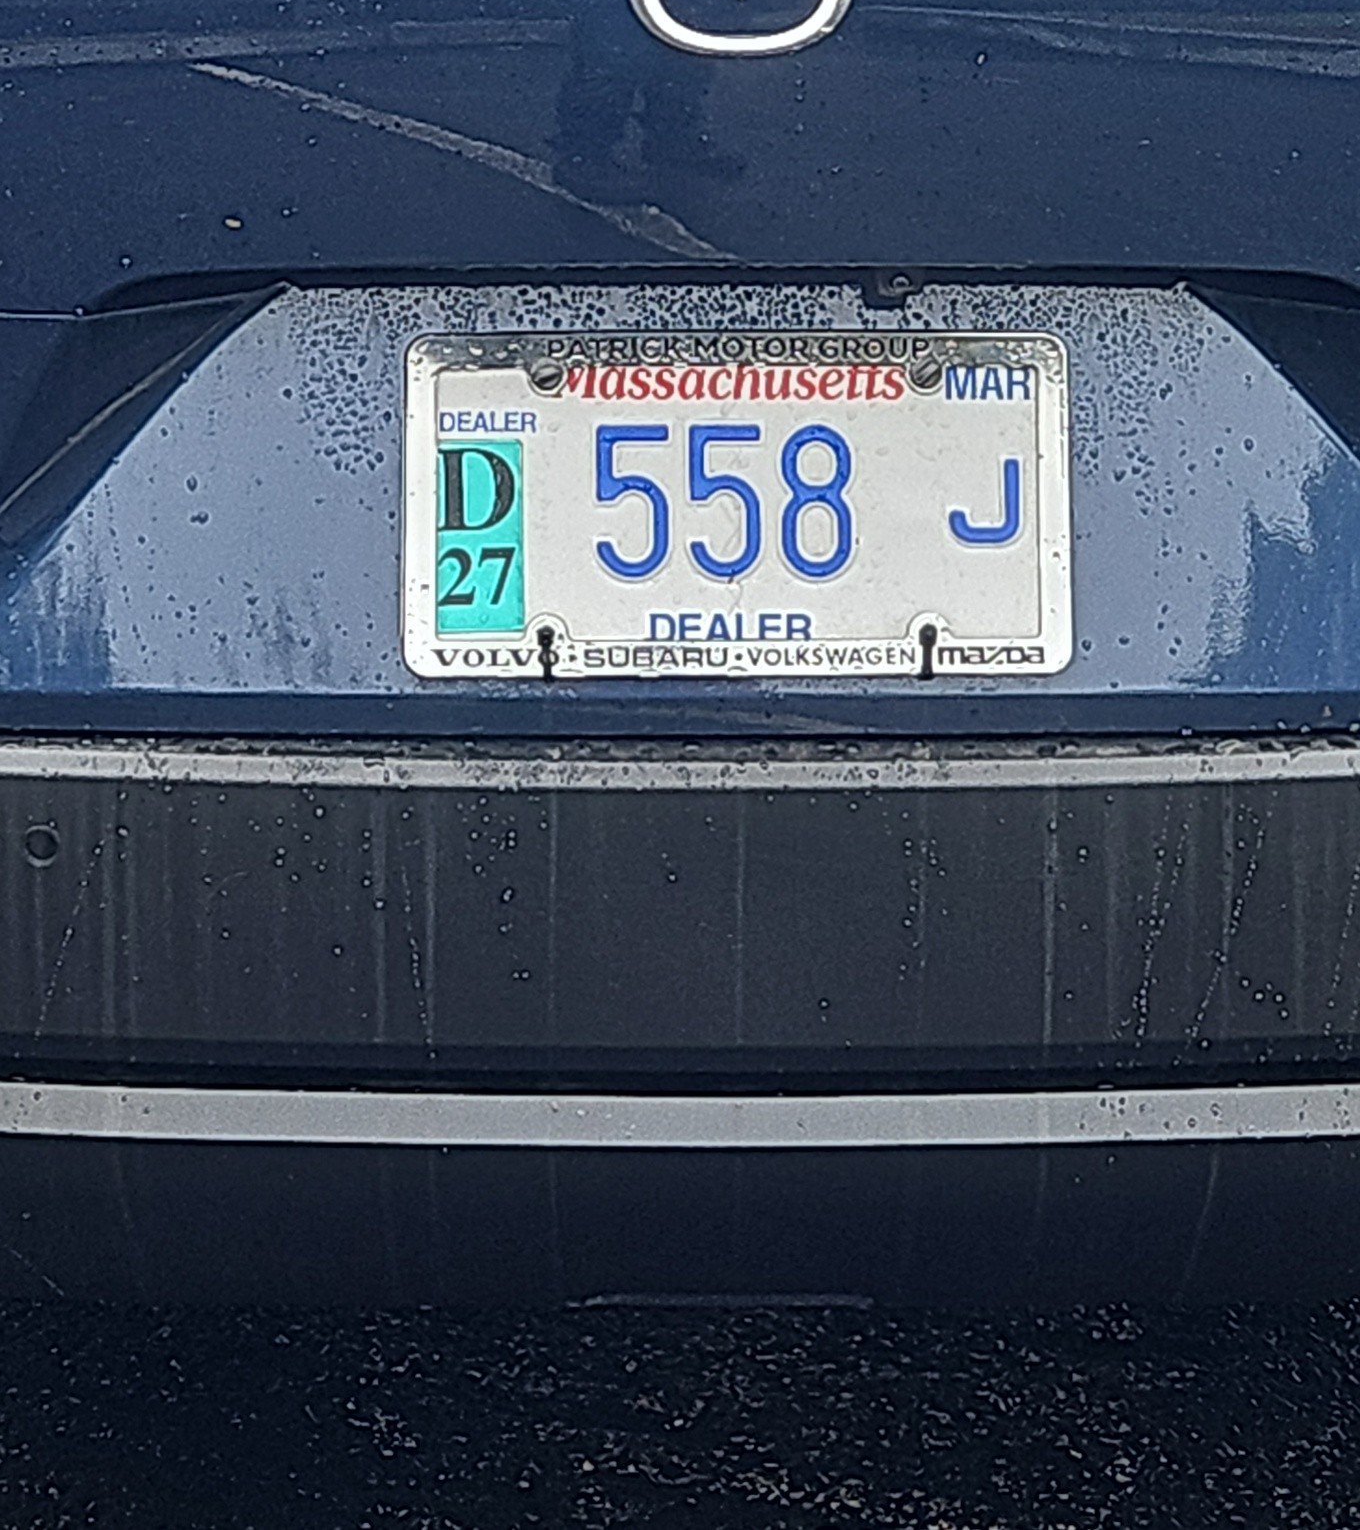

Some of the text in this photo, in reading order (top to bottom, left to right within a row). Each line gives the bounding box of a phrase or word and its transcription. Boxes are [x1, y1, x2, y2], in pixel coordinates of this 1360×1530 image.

[548, 337, 930, 359] PATRICK MOTOR GROUP
[945, 367, 1031, 400] MAR
[440, 411, 537, 433] DEALER
[438, 448, 516, 530] D
[595, 424, 852, 578] 558
[948, 458, 1020, 543] J
[439, 547, 516, 606] 27
[431, 648, 559, 668] VOLVO
[583, 646, 727, 668] SUBARU
[746, 646, 917, 666] VOLKSWAGEN
